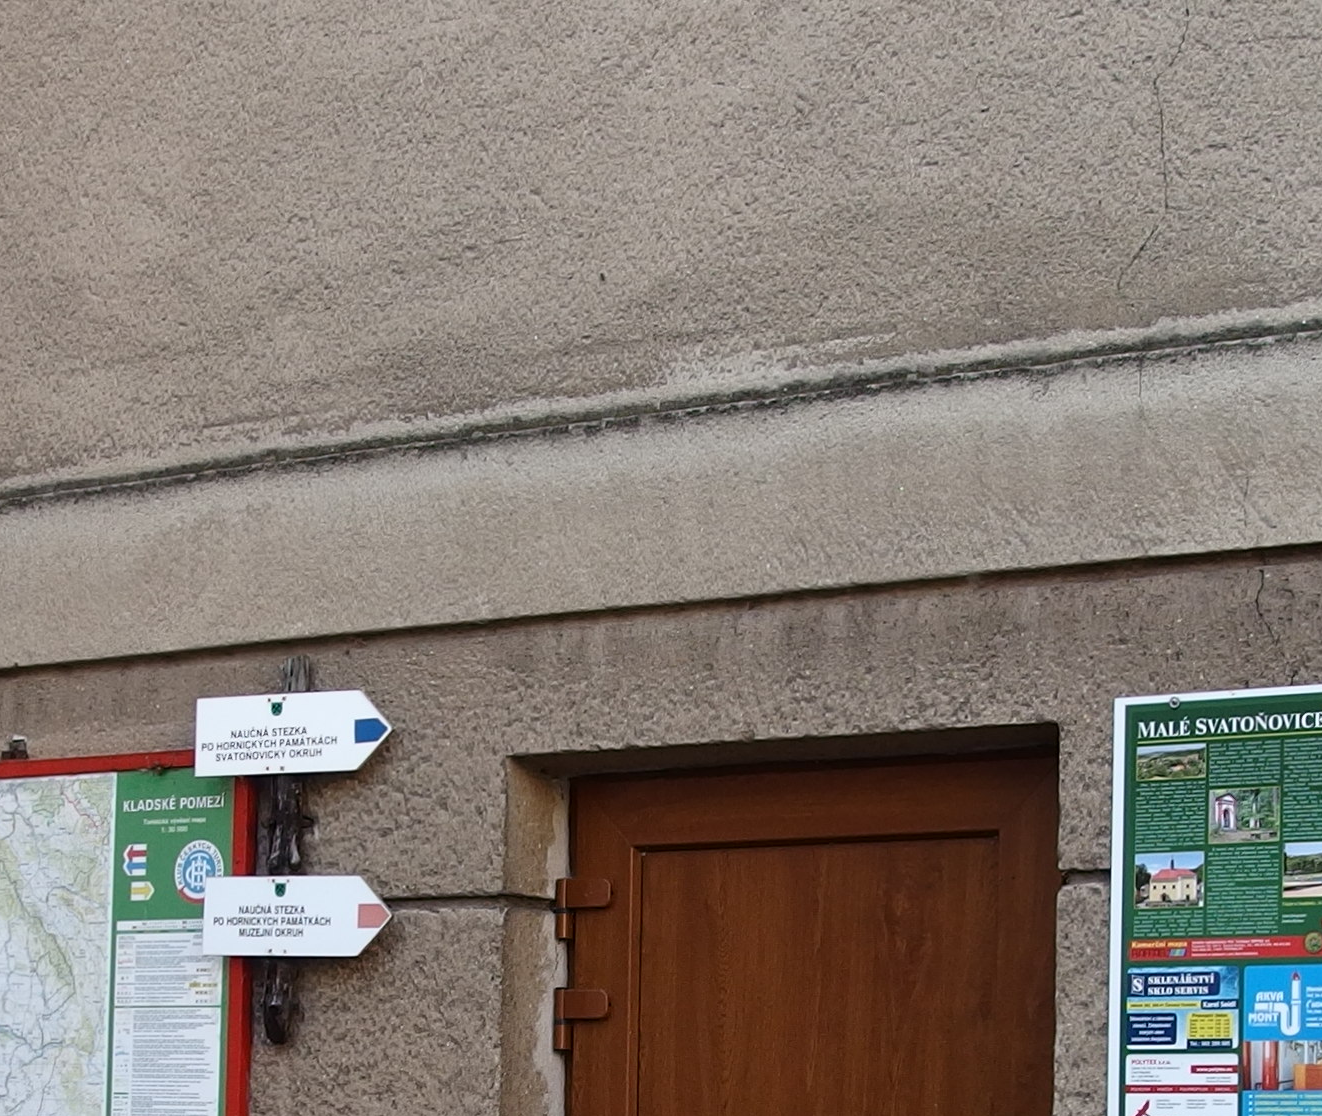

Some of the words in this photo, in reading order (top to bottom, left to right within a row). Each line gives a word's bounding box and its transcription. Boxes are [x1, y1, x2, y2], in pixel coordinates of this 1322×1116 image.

[231, 726, 269, 739] NAUČNÁ
[272, 726, 307, 737] STEZKA
[1137, 716, 1191, 739] MALÉ
[201, 742, 214, 752] PO
[216, 738, 277, 751] HORNICKÝCH
[280, 734, 337, 748] PAMÁTKÁCH
[289, 748, 323, 758] OKRUH
[123, 795, 176, 812] KLADSKÉ
[180, 793, 225, 809] POMEZÍ
[238, 904, 272, 915] NAUČNÁ
[274, 905, 305, 914] STEZKA
[213, 917, 224, 925] PO
[227, 914, 278, 926] HORNICKÝCH
[281, 914, 331, 926] PAMÁTKÁCH
[238, 926, 273, 937] MUZEJNÍ
[275, 927, 304, 937] OKRUH
[1148, 987, 1173, 995] SKLO
[1175, 986, 1209, 994] SERVIS
[1249, 1013, 1279, 1022] MONT
